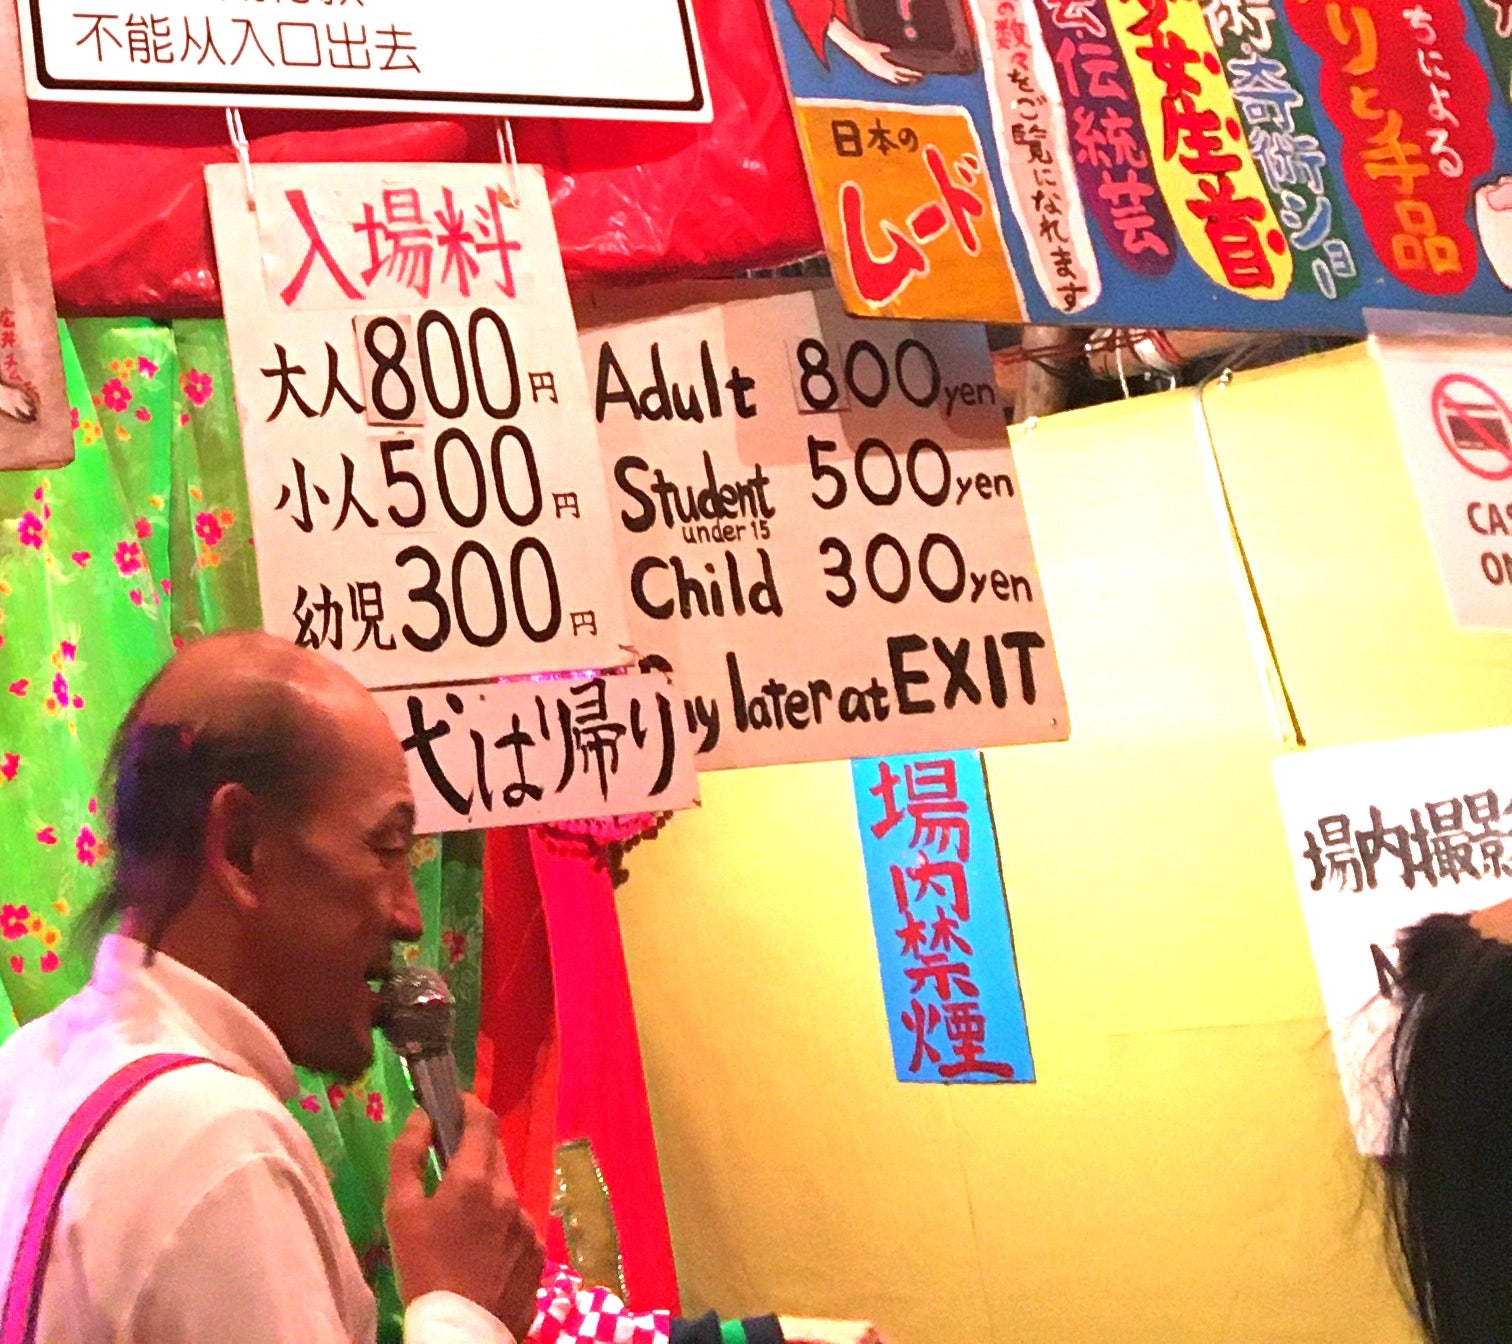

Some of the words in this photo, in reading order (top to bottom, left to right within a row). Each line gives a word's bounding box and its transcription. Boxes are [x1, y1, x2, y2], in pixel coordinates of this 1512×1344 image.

[74, 13, 422, 75] 不能从入口出去
[834, 118, 919, 158] 日本の
[279, 187, 522, 303] 入場料
[595, 340, 758, 423] Adult
[615, 450, 776, 534] Student
[682, 518, 746, 544] under
[750, 517, 771, 540] 15
[631, 547, 784, 621] Child
[726, 651, 833, 733] later
[837, 675, 891, 724] at
[886, 631, 1046, 715] EXIT
[869, 760, 1015, 1080] 場内禁煙
